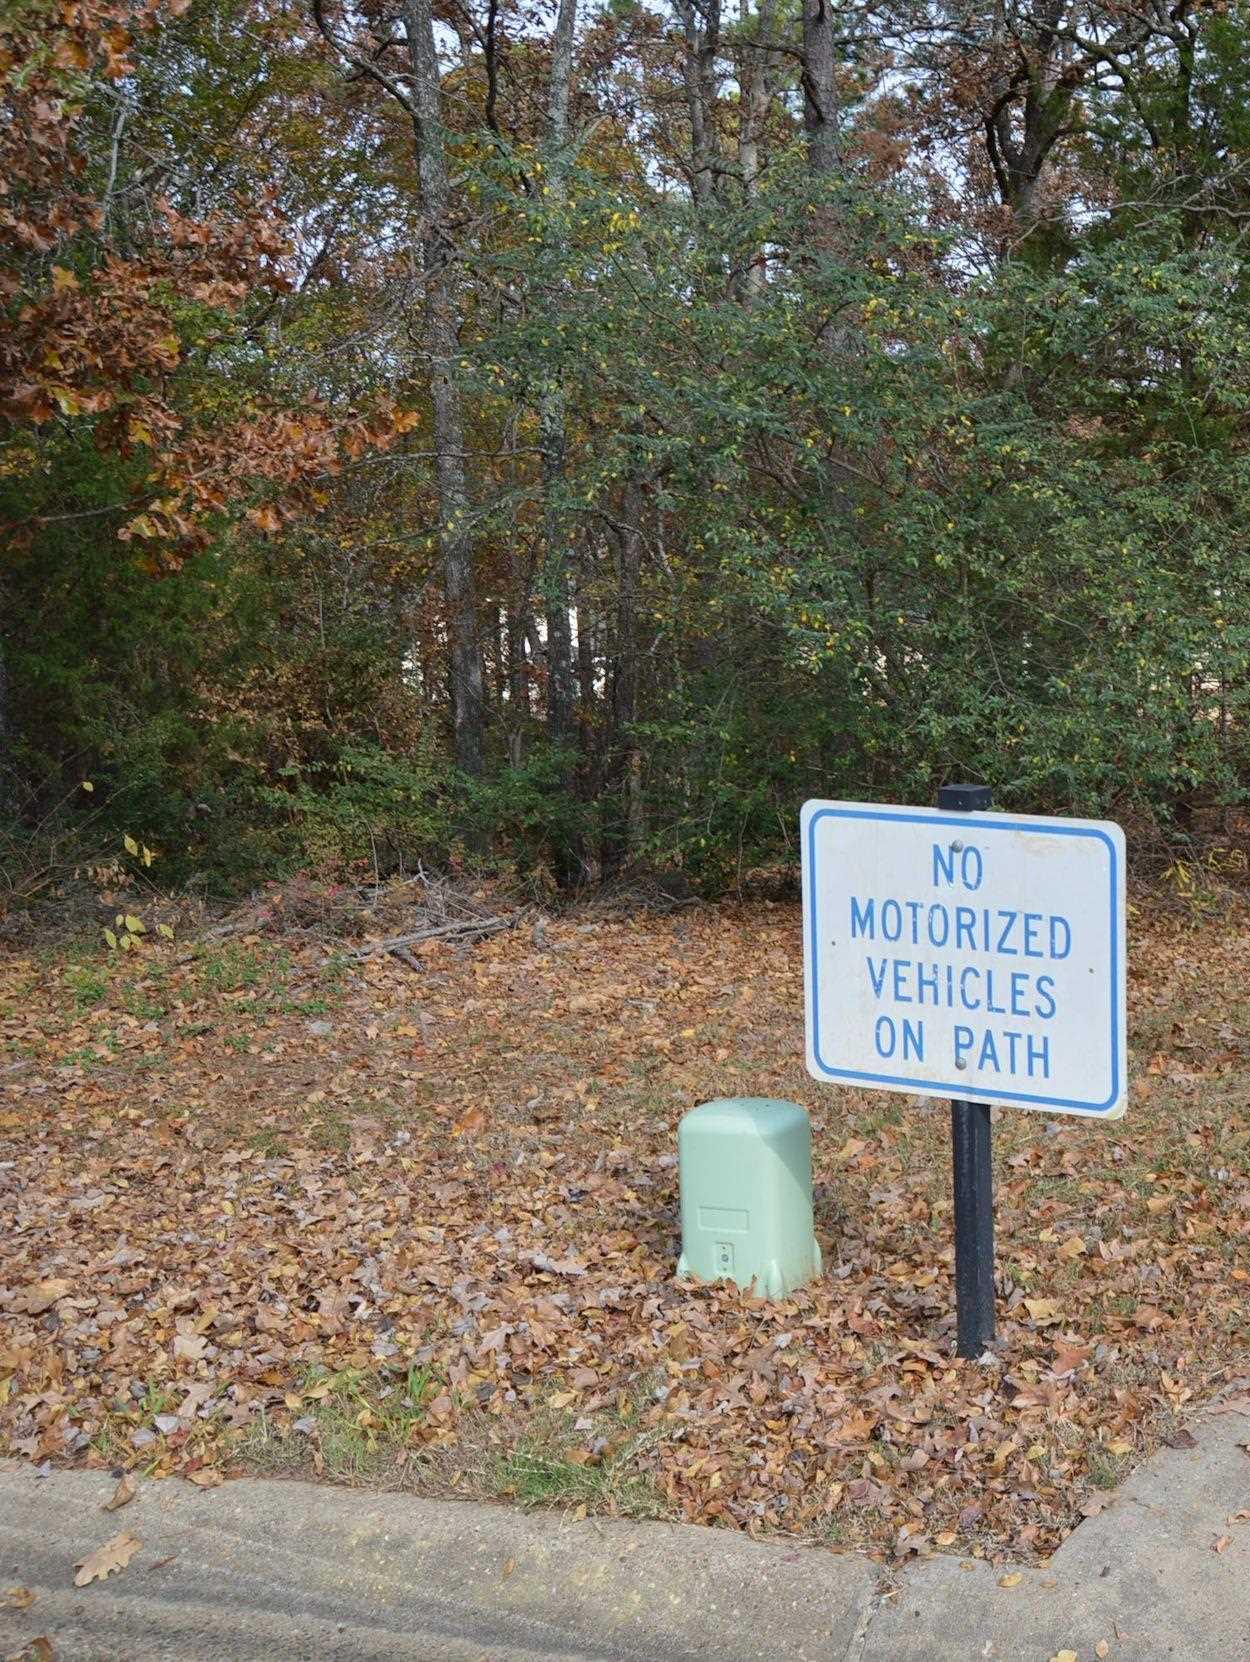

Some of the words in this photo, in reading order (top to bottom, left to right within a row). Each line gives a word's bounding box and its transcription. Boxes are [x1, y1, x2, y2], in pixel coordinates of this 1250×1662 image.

[932, 843, 983, 890] NO
[850, 896, 1072, 960] MOTORIZED
[866, 956, 1057, 1019] VEHICLES
[875, 1015, 924, 1062] ON
[954, 1025, 1050, 1079] PATH
